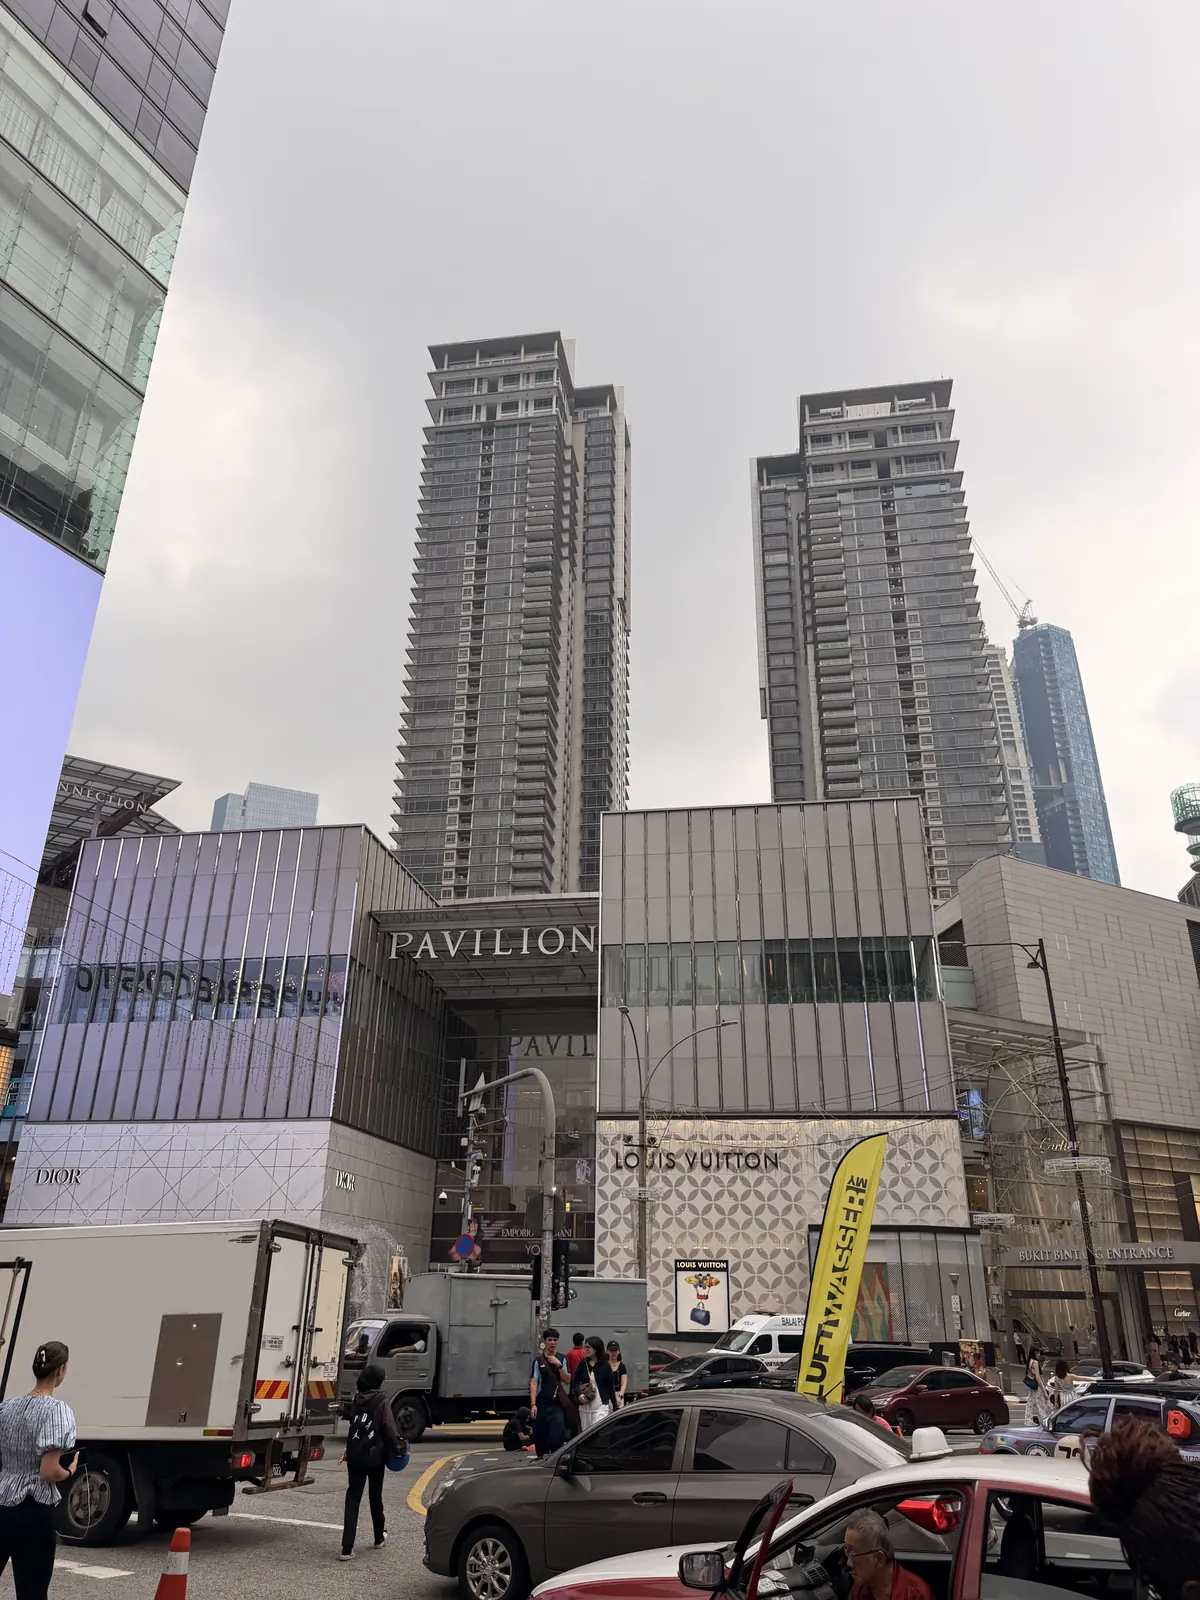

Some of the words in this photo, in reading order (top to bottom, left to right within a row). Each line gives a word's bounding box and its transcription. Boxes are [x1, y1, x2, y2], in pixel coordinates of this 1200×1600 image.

[389, 925, 597, 960] PAVILION
[615, 1152, 676, 1169] LOUIS
[685, 1152, 779, 1170] VUITTON
[35, 1168, 81, 1185] DIOR
[335, 1170, 356, 1191] DIOR
[847, 1175, 868, 1188] MY
[1018, 1250, 1050, 1262] BUKIT
[1053, 1249, 1103, 1261] BINTG
[1106, 1246, 1174, 1261] ENTRANCE
[1174, 1307, 1191, 1317] Cartier
[781, 1317, 797, 1326] BALAI
